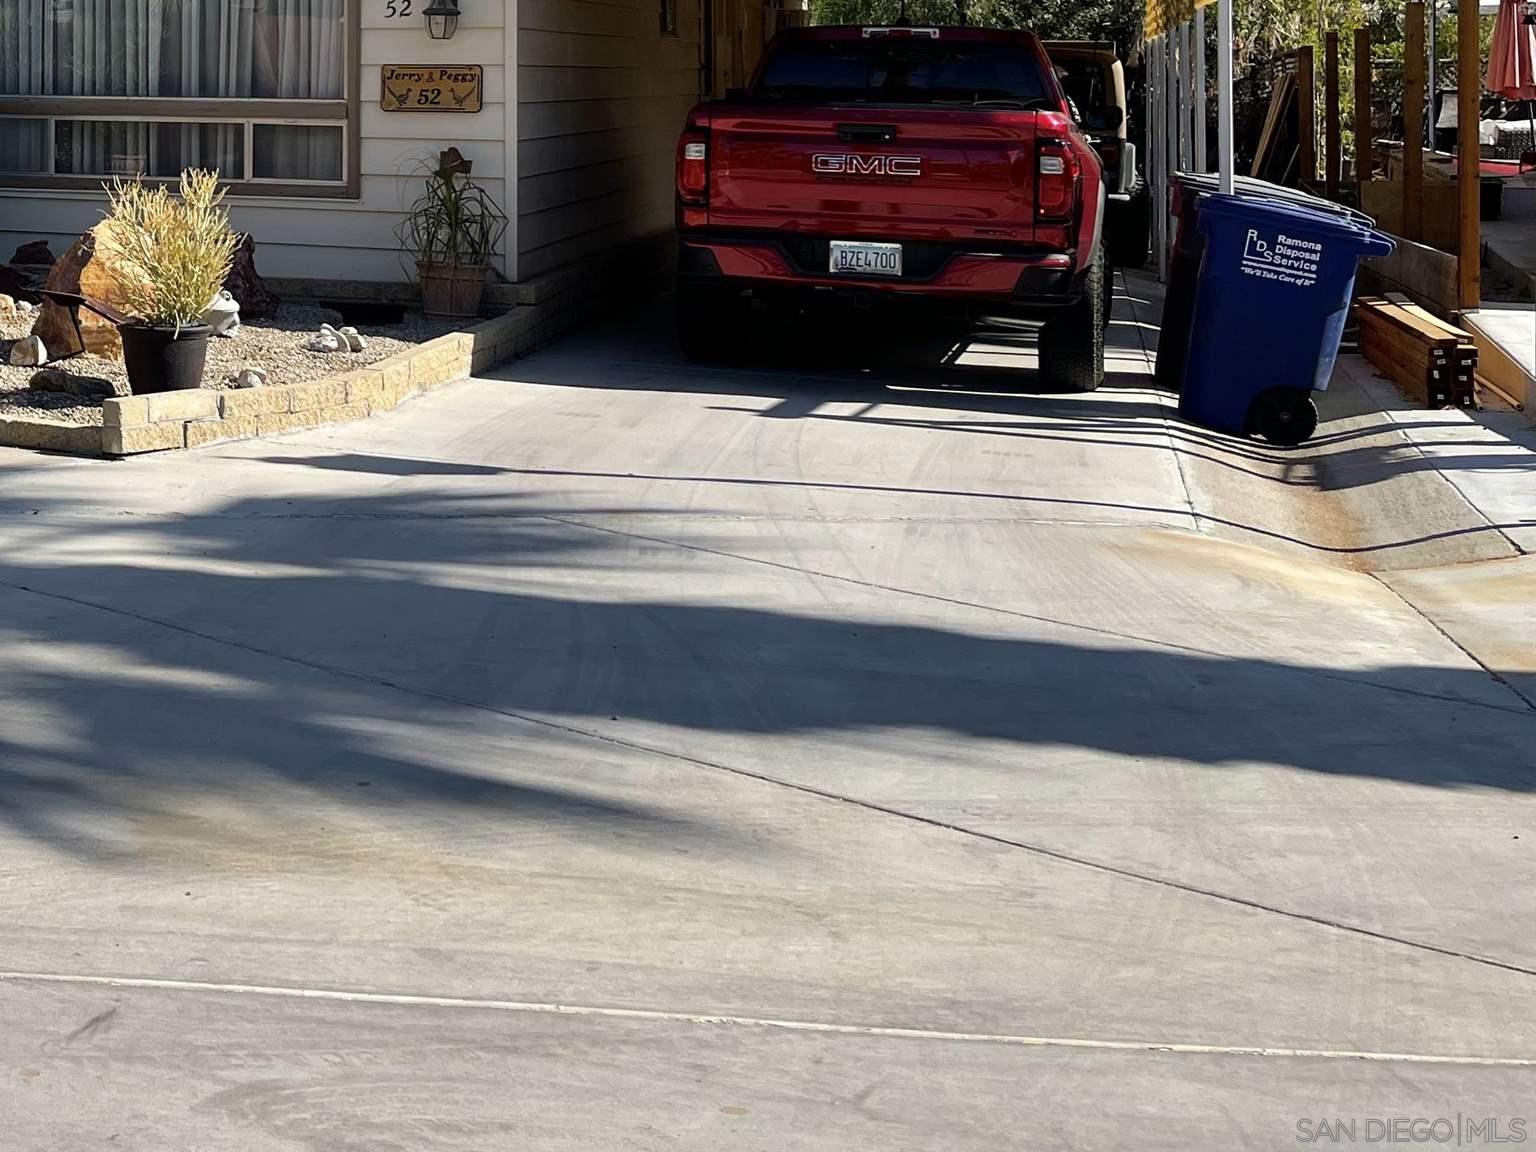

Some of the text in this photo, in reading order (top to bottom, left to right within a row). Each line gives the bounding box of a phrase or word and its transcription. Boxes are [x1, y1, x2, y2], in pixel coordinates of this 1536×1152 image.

[386, 69, 477, 83] Jerry & Peggy
[417, 88, 442, 105] 52
[812, 153, 921, 176] GMC
[1277, 234, 1322, 251] Ramona
[840, 250, 897, 269] BZE4700
[1275, 244, 1321, 261] Disposal
[1272, 255, 1318, 271] Service
